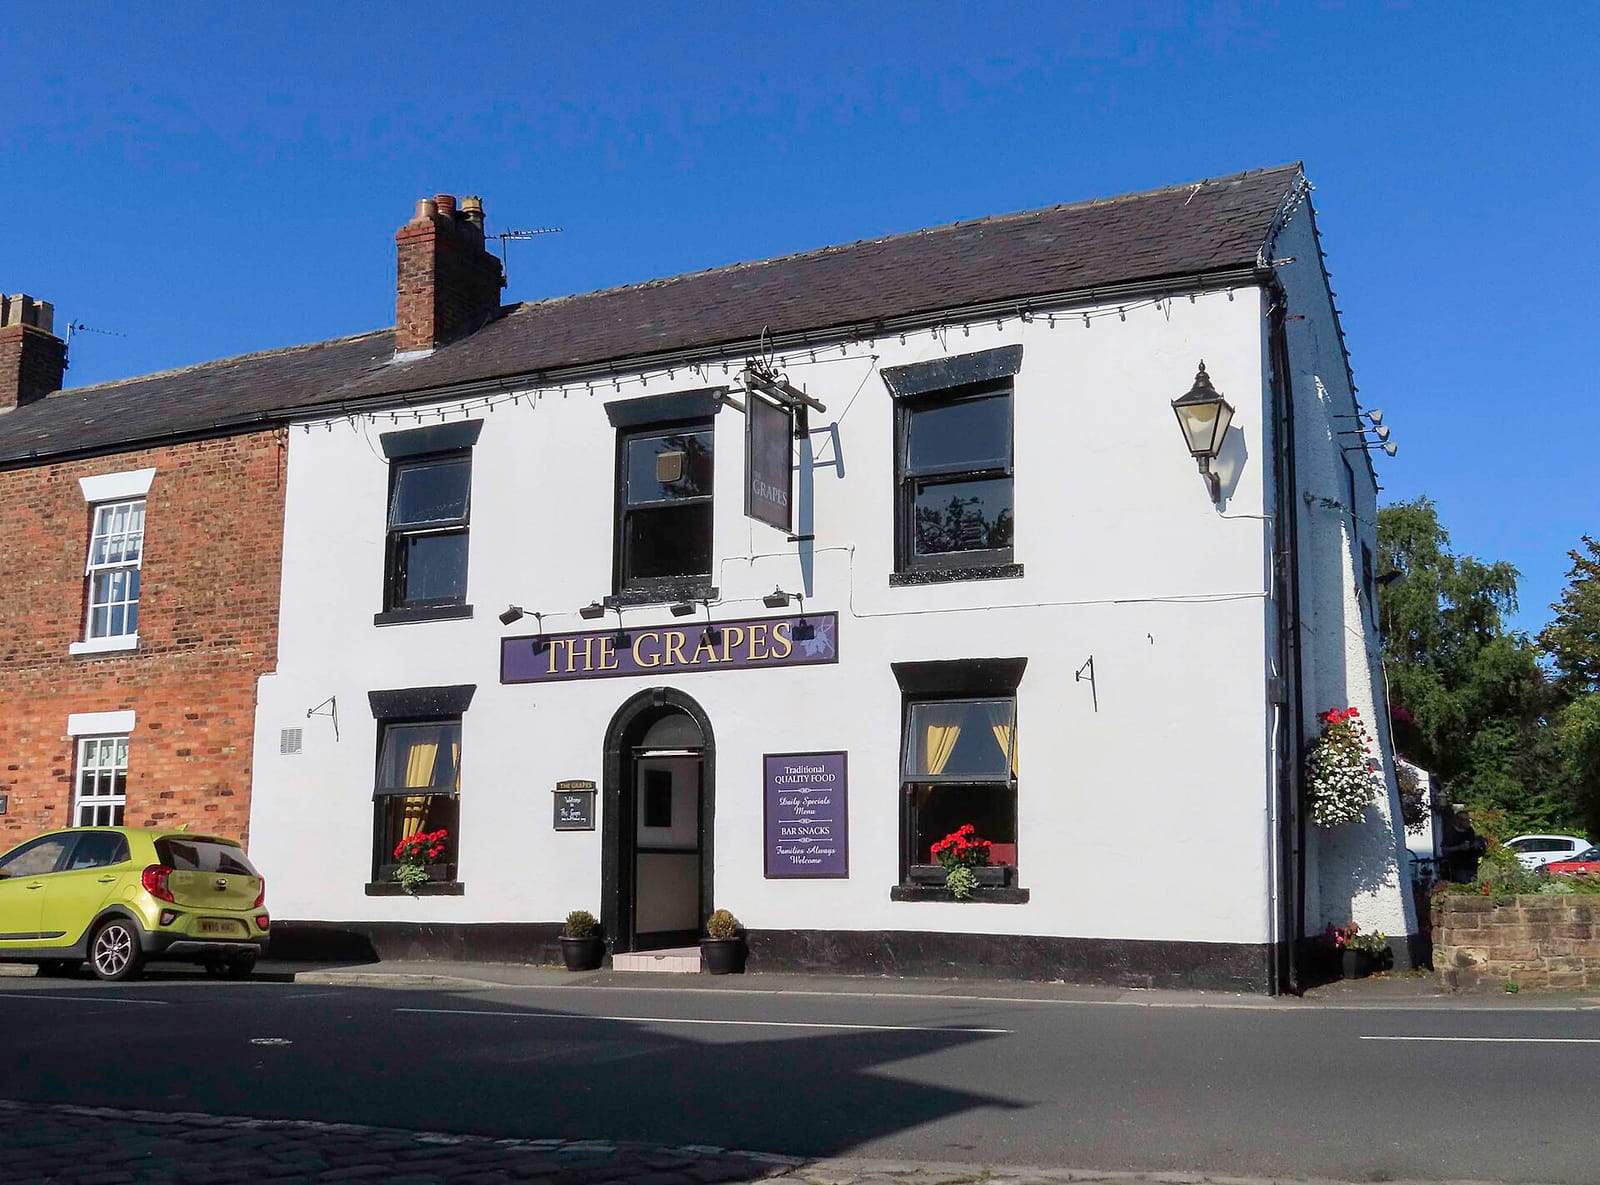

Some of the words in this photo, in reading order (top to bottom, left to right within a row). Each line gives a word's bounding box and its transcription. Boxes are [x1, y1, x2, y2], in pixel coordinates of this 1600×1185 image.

[753, 479, 787, 506] GRAPES
[546, 636, 619, 673] THE
[632, 623, 793, 667] GRAPES
[784, 765, 825, 774] Traditional
[774, 775, 810, 784] QUALITY
[811, 774, 836, 782] FOOD
[779, 797, 800, 808] Daily
[802, 796, 831, 807] Specials
[794, 807, 816, 815] Menu
[781, 827, 797, 835] BAR
[798, 827, 830, 835] SNACKS
[775, 845, 804, 855] Families
[806, 845, 836, 856] Always
[789, 855, 822, 864] Welcome
